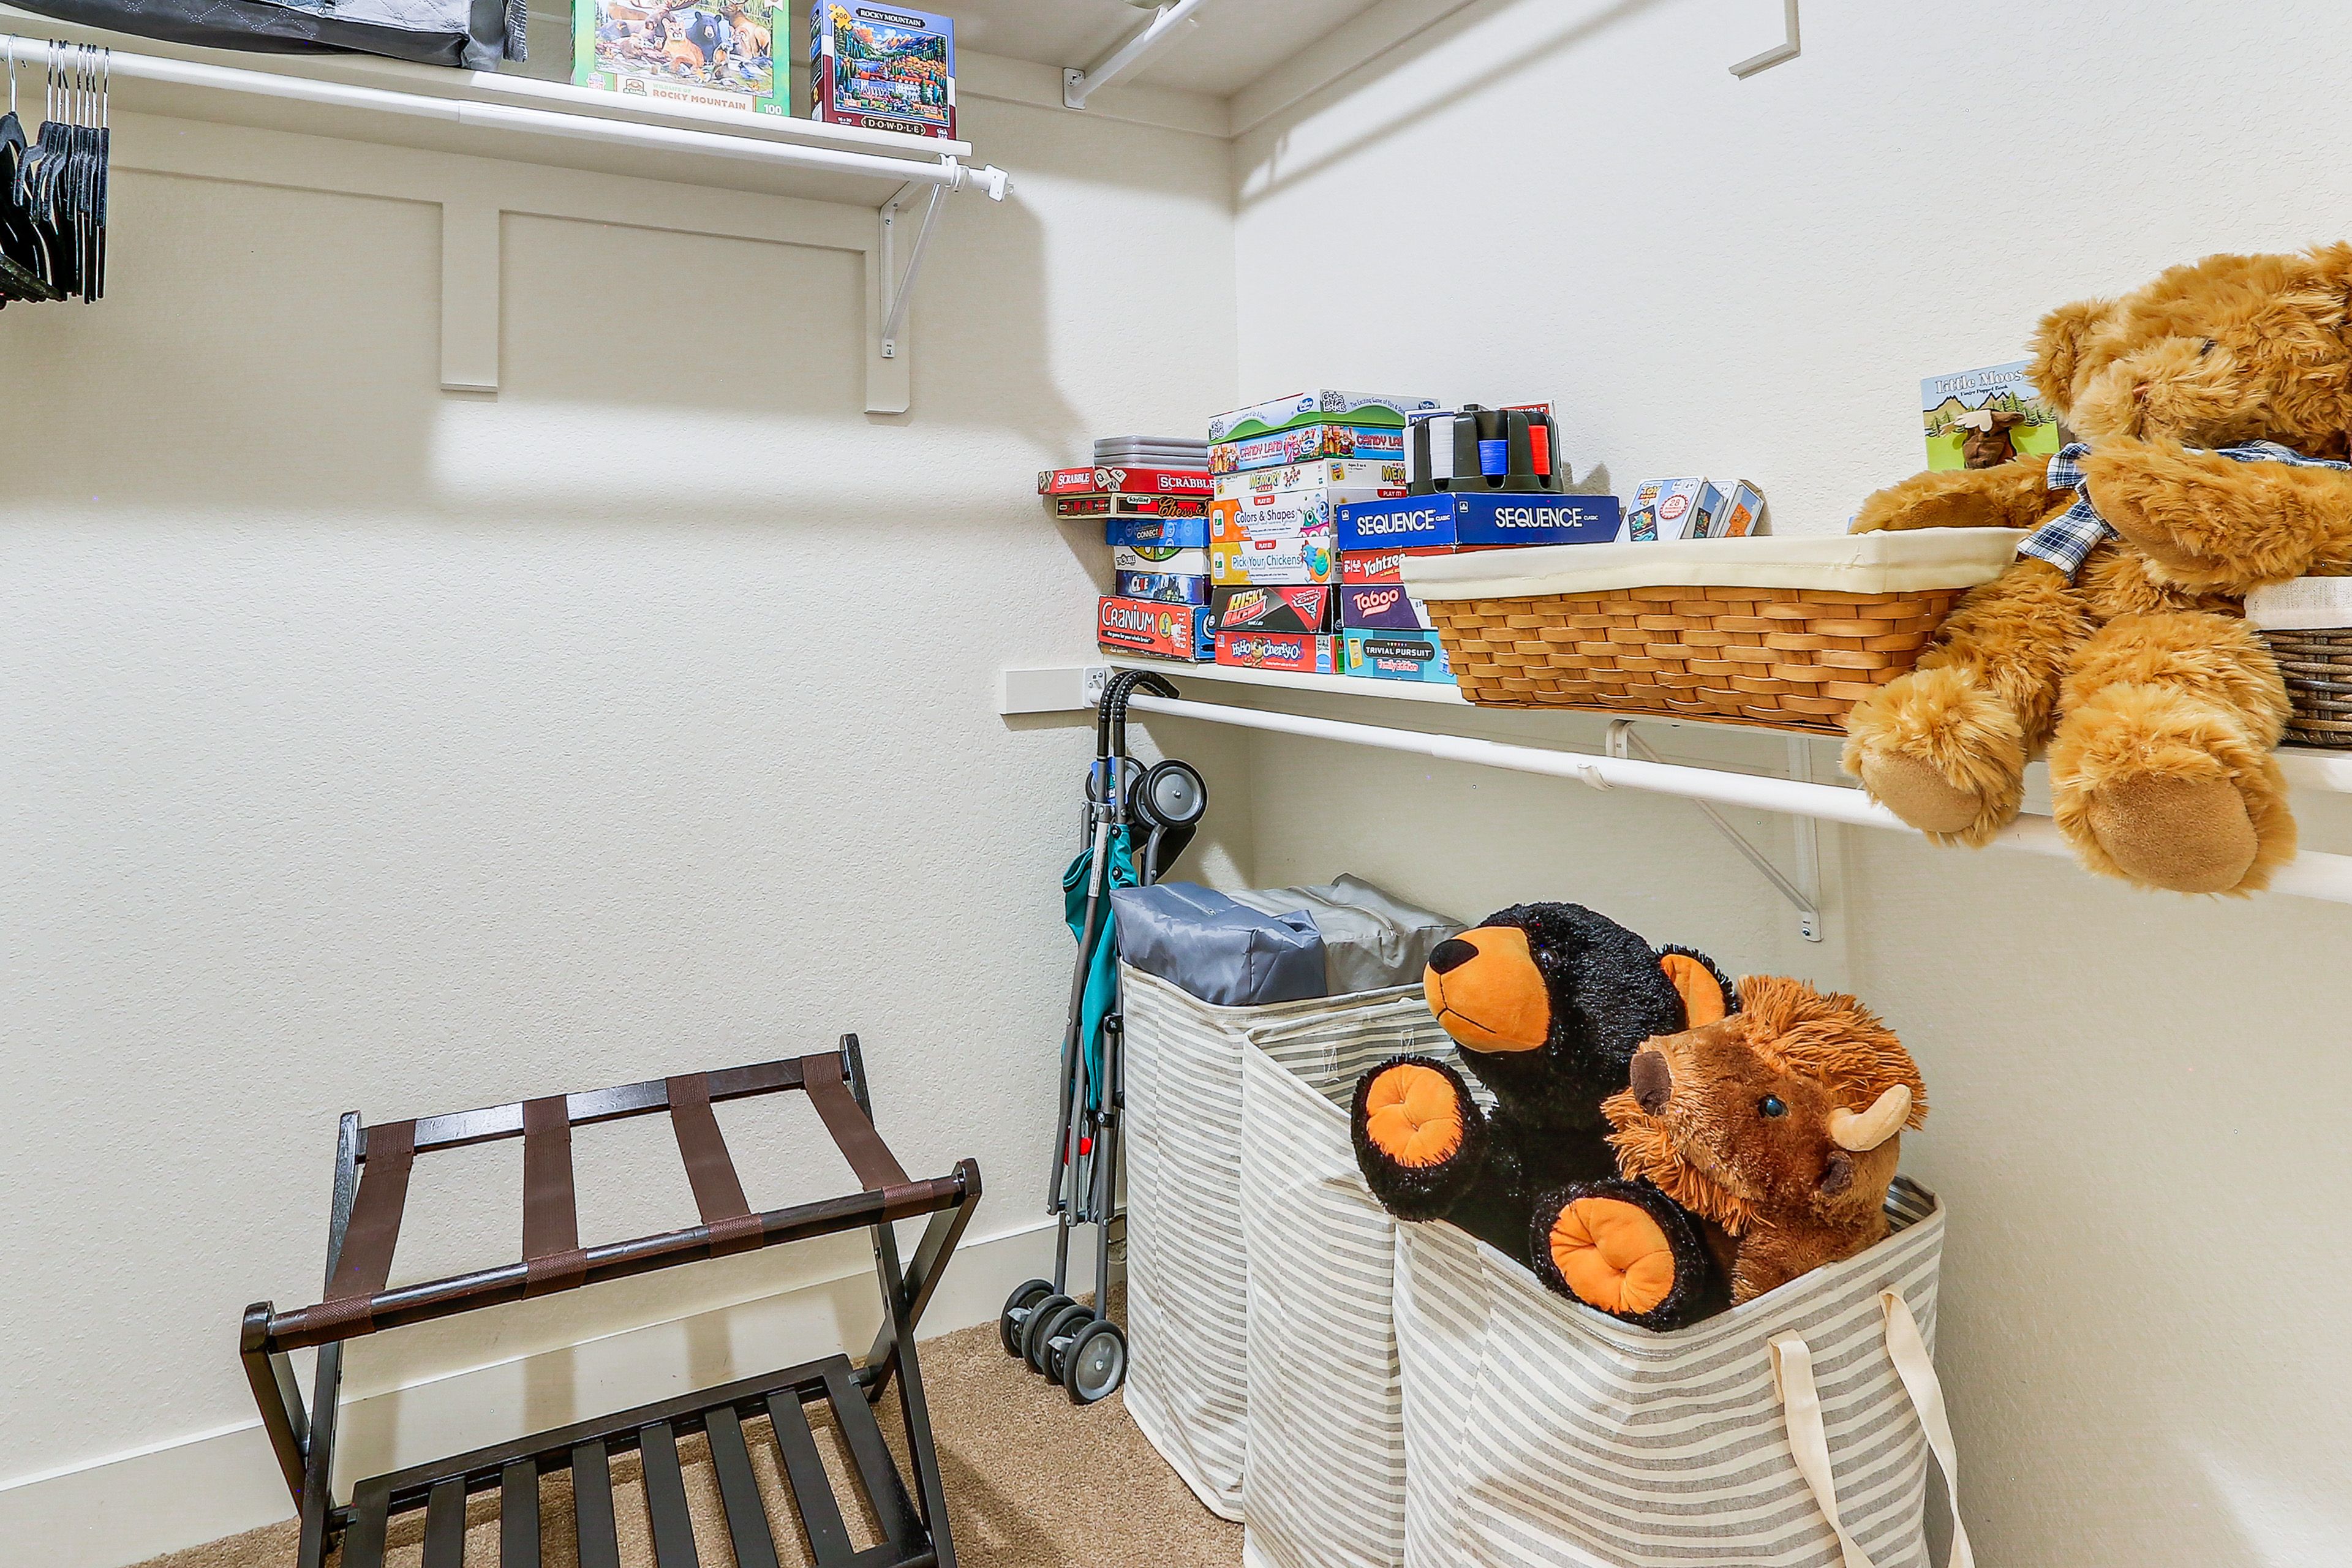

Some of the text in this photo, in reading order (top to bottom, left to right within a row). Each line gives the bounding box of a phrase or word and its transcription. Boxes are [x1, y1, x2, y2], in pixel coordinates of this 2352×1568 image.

[860, 10, 921, 26] ROCKY MOUNTAIN
[652, 89, 688, 101] ROCKY
[691, 95, 746, 110] MOUNTAIN
[763, 104, 782, 115] 100
[1935, 370, 2029, 394] Little Moos
[1356, 434, 1403, 447] CANDY LA
[1240, 440, 1283, 458] CANDY LAND
[1058, 472, 1090, 486] SCRABBLE
[1159, 477, 1215, 489] SCRABBLE
[1249, 471, 1281, 490] MEMORY
[1641, 485, 1662, 494] TOY
[1158, 496, 1193, 517] Chess
[1196, 505, 1204, 514] &
[1235, 510, 1295, 524] Colors & Shapes
[1357, 510, 1434, 535] SEQUENCE
[1495, 507, 1583, 529] SEQUENCE
[1136, 528, 1158, 540] CONNECT
[1232, 555, 1300, 567] Pick Your Chickens
[1228, 588, 1264, 611] RISKY
[1352, 589, 1400, 611] Taboo
[1365, 646, 1431, 657] TRIVIAL PURSUIT
[1377, 659, 1419, 673] Family Edition
